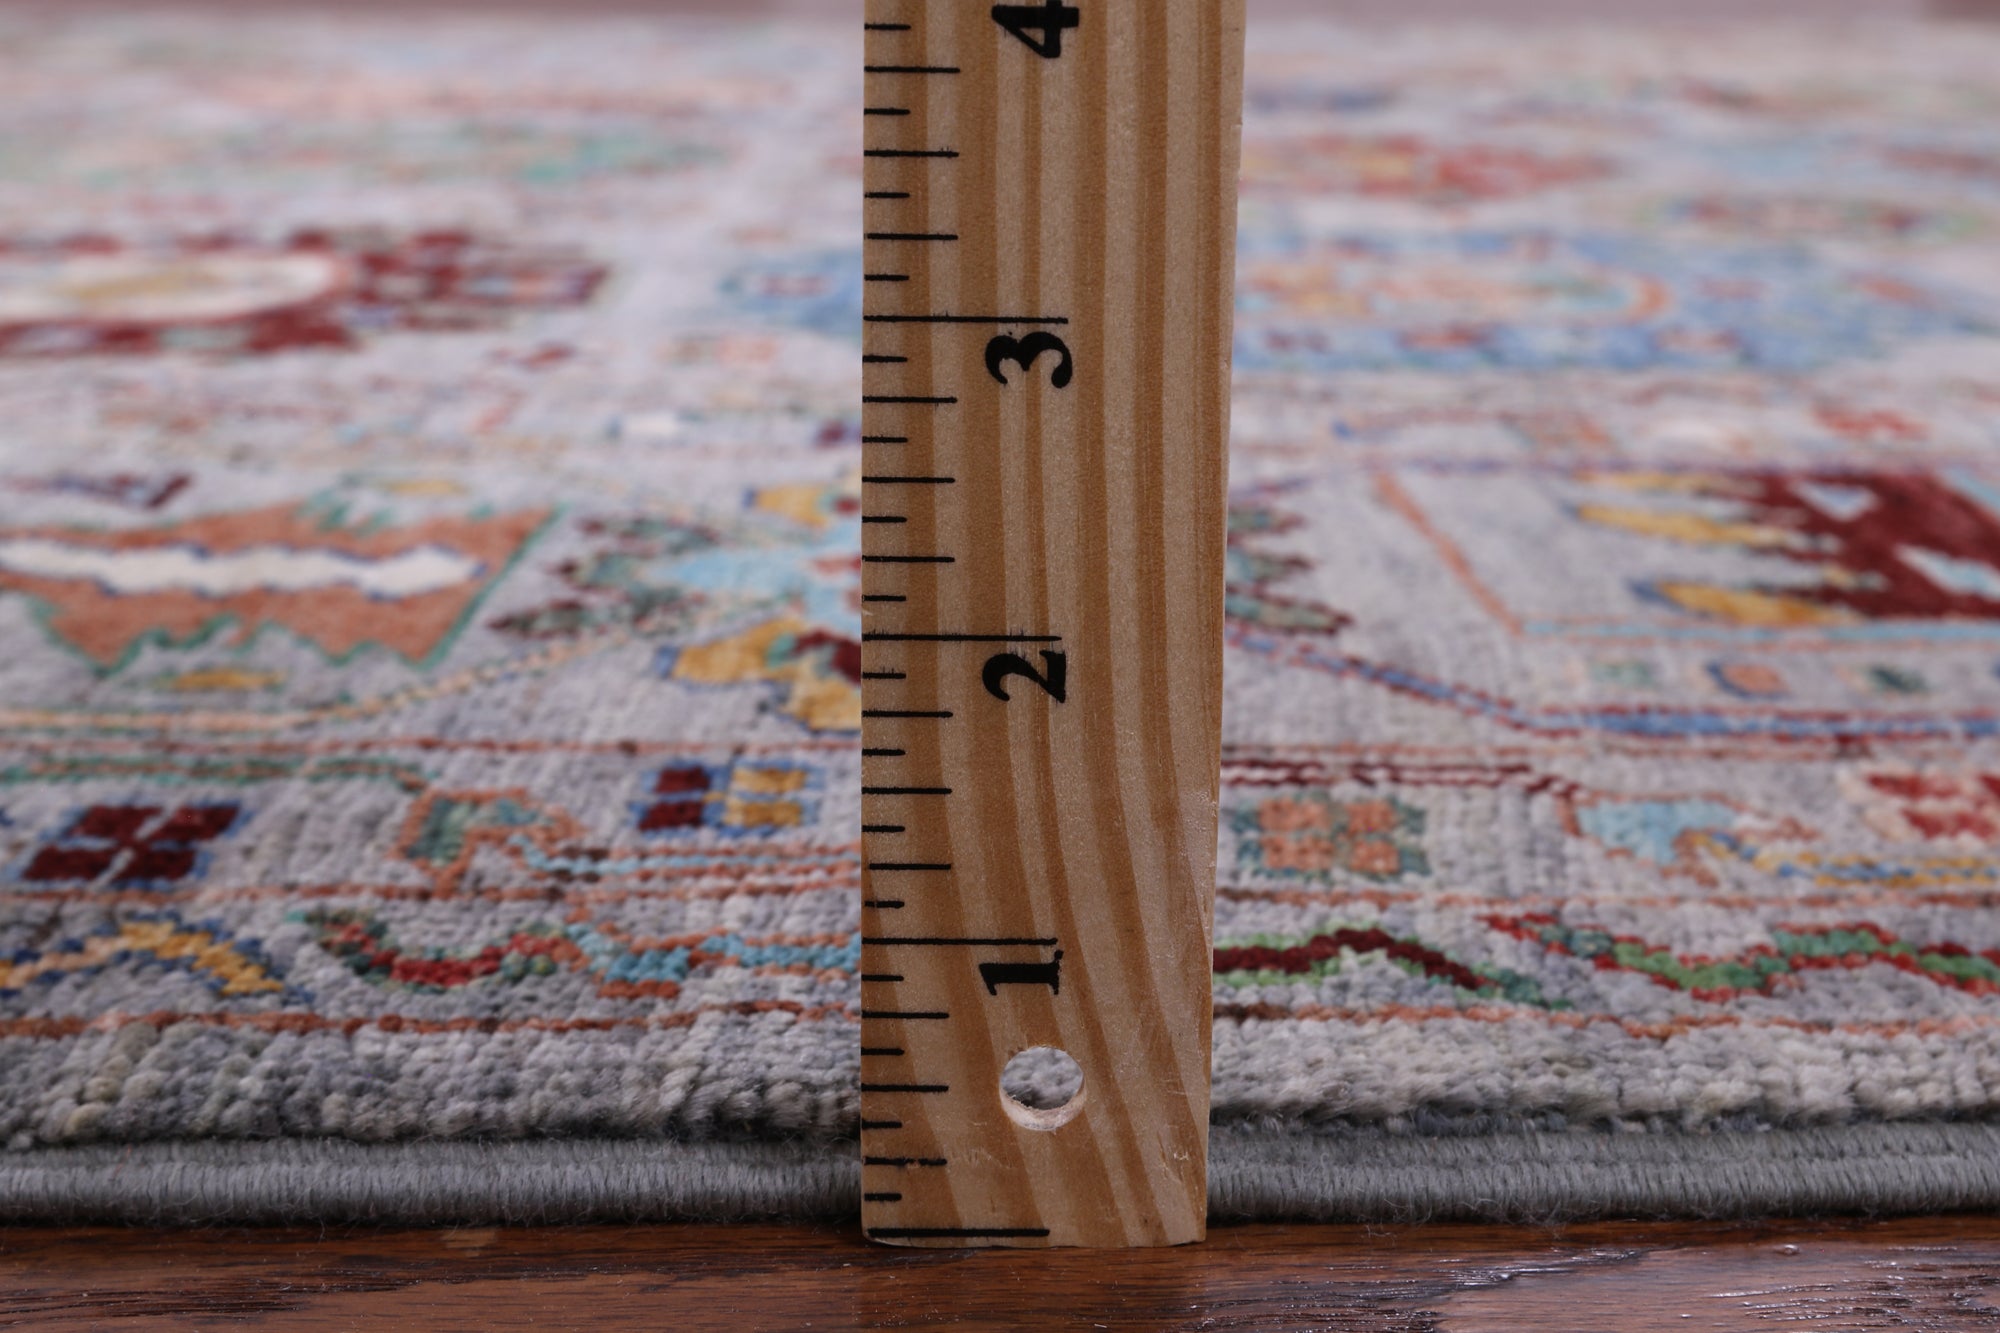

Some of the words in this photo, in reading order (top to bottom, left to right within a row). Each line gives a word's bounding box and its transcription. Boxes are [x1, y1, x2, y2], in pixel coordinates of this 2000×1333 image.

[991, 0, 1080, 59] 4
[984, 331, 1073, 389] 3
[981, 649, 1067, 704] 2
[978, 950, 1064, 996] 1
